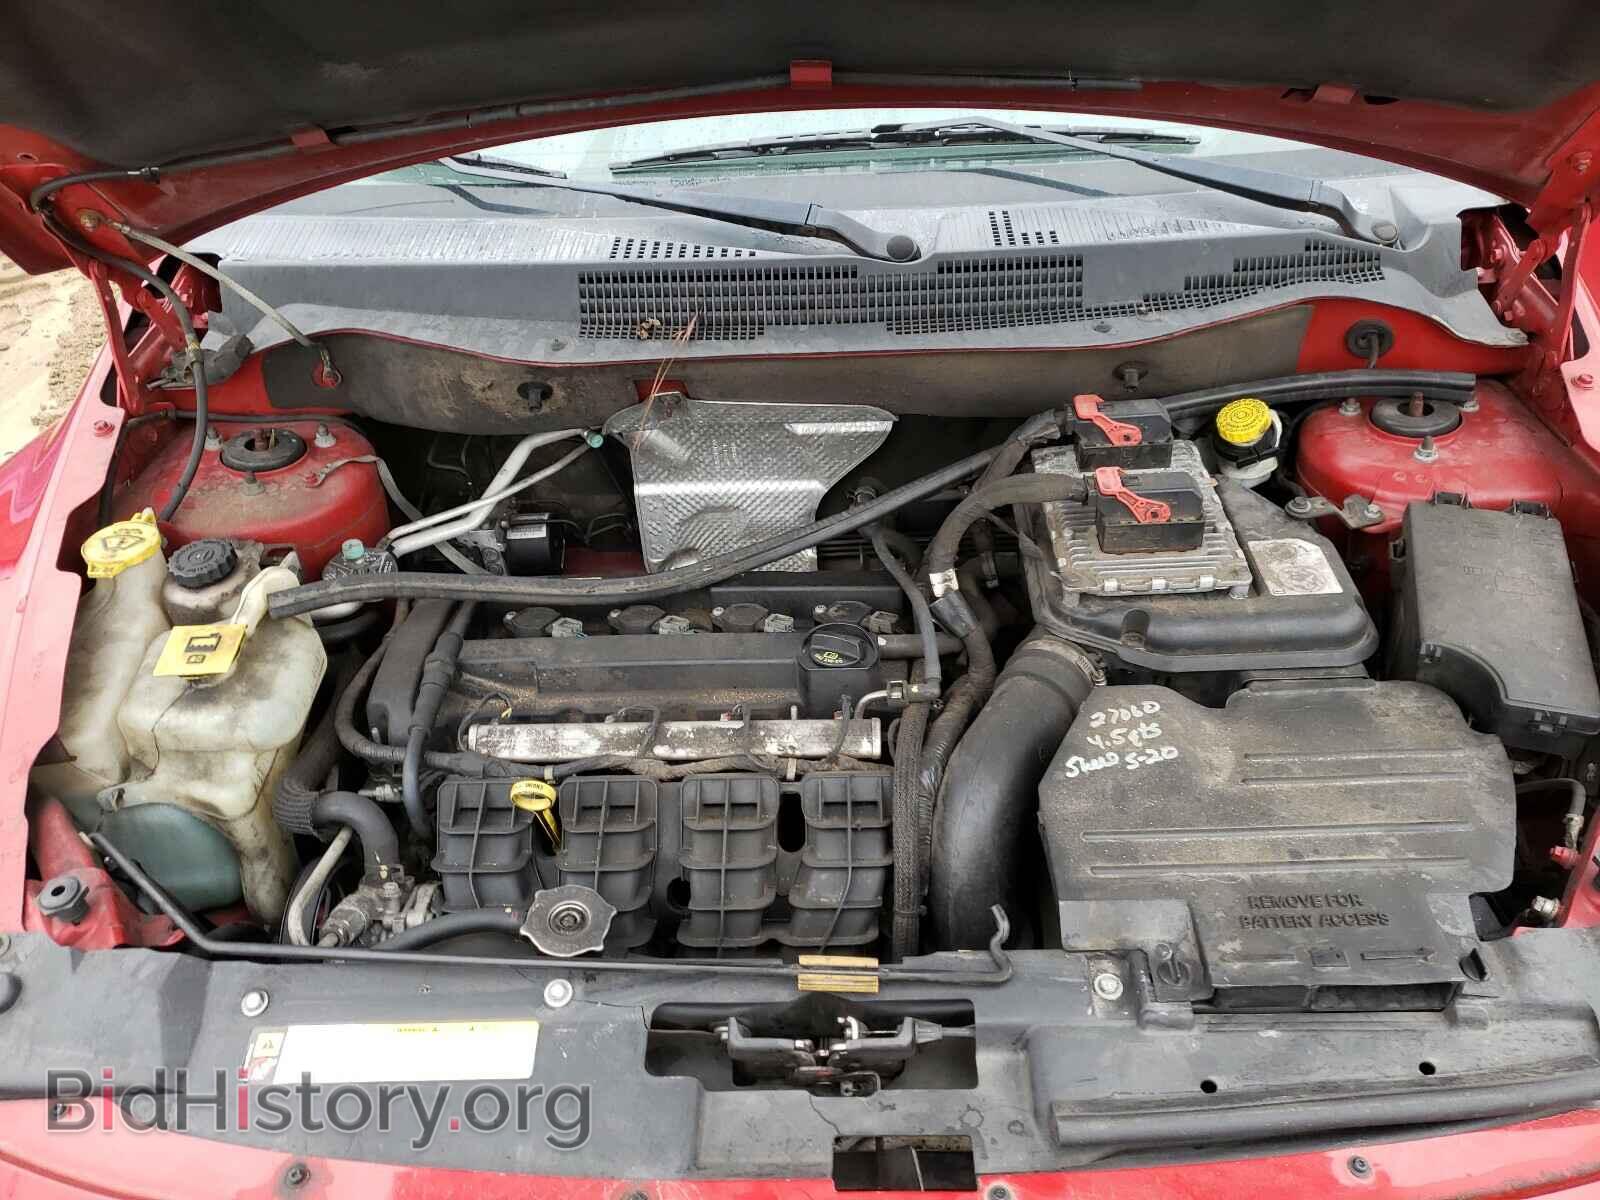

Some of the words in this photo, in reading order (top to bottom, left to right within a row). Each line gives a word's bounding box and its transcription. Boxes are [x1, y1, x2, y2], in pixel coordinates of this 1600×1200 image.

[1247, 894, 1321, 909] REMOVE
[1324, 893, 1364, 908] FOR
[1239, 914, 1313, 929] BATTERY
[1319, 912, 1391, 928] ACCESS
